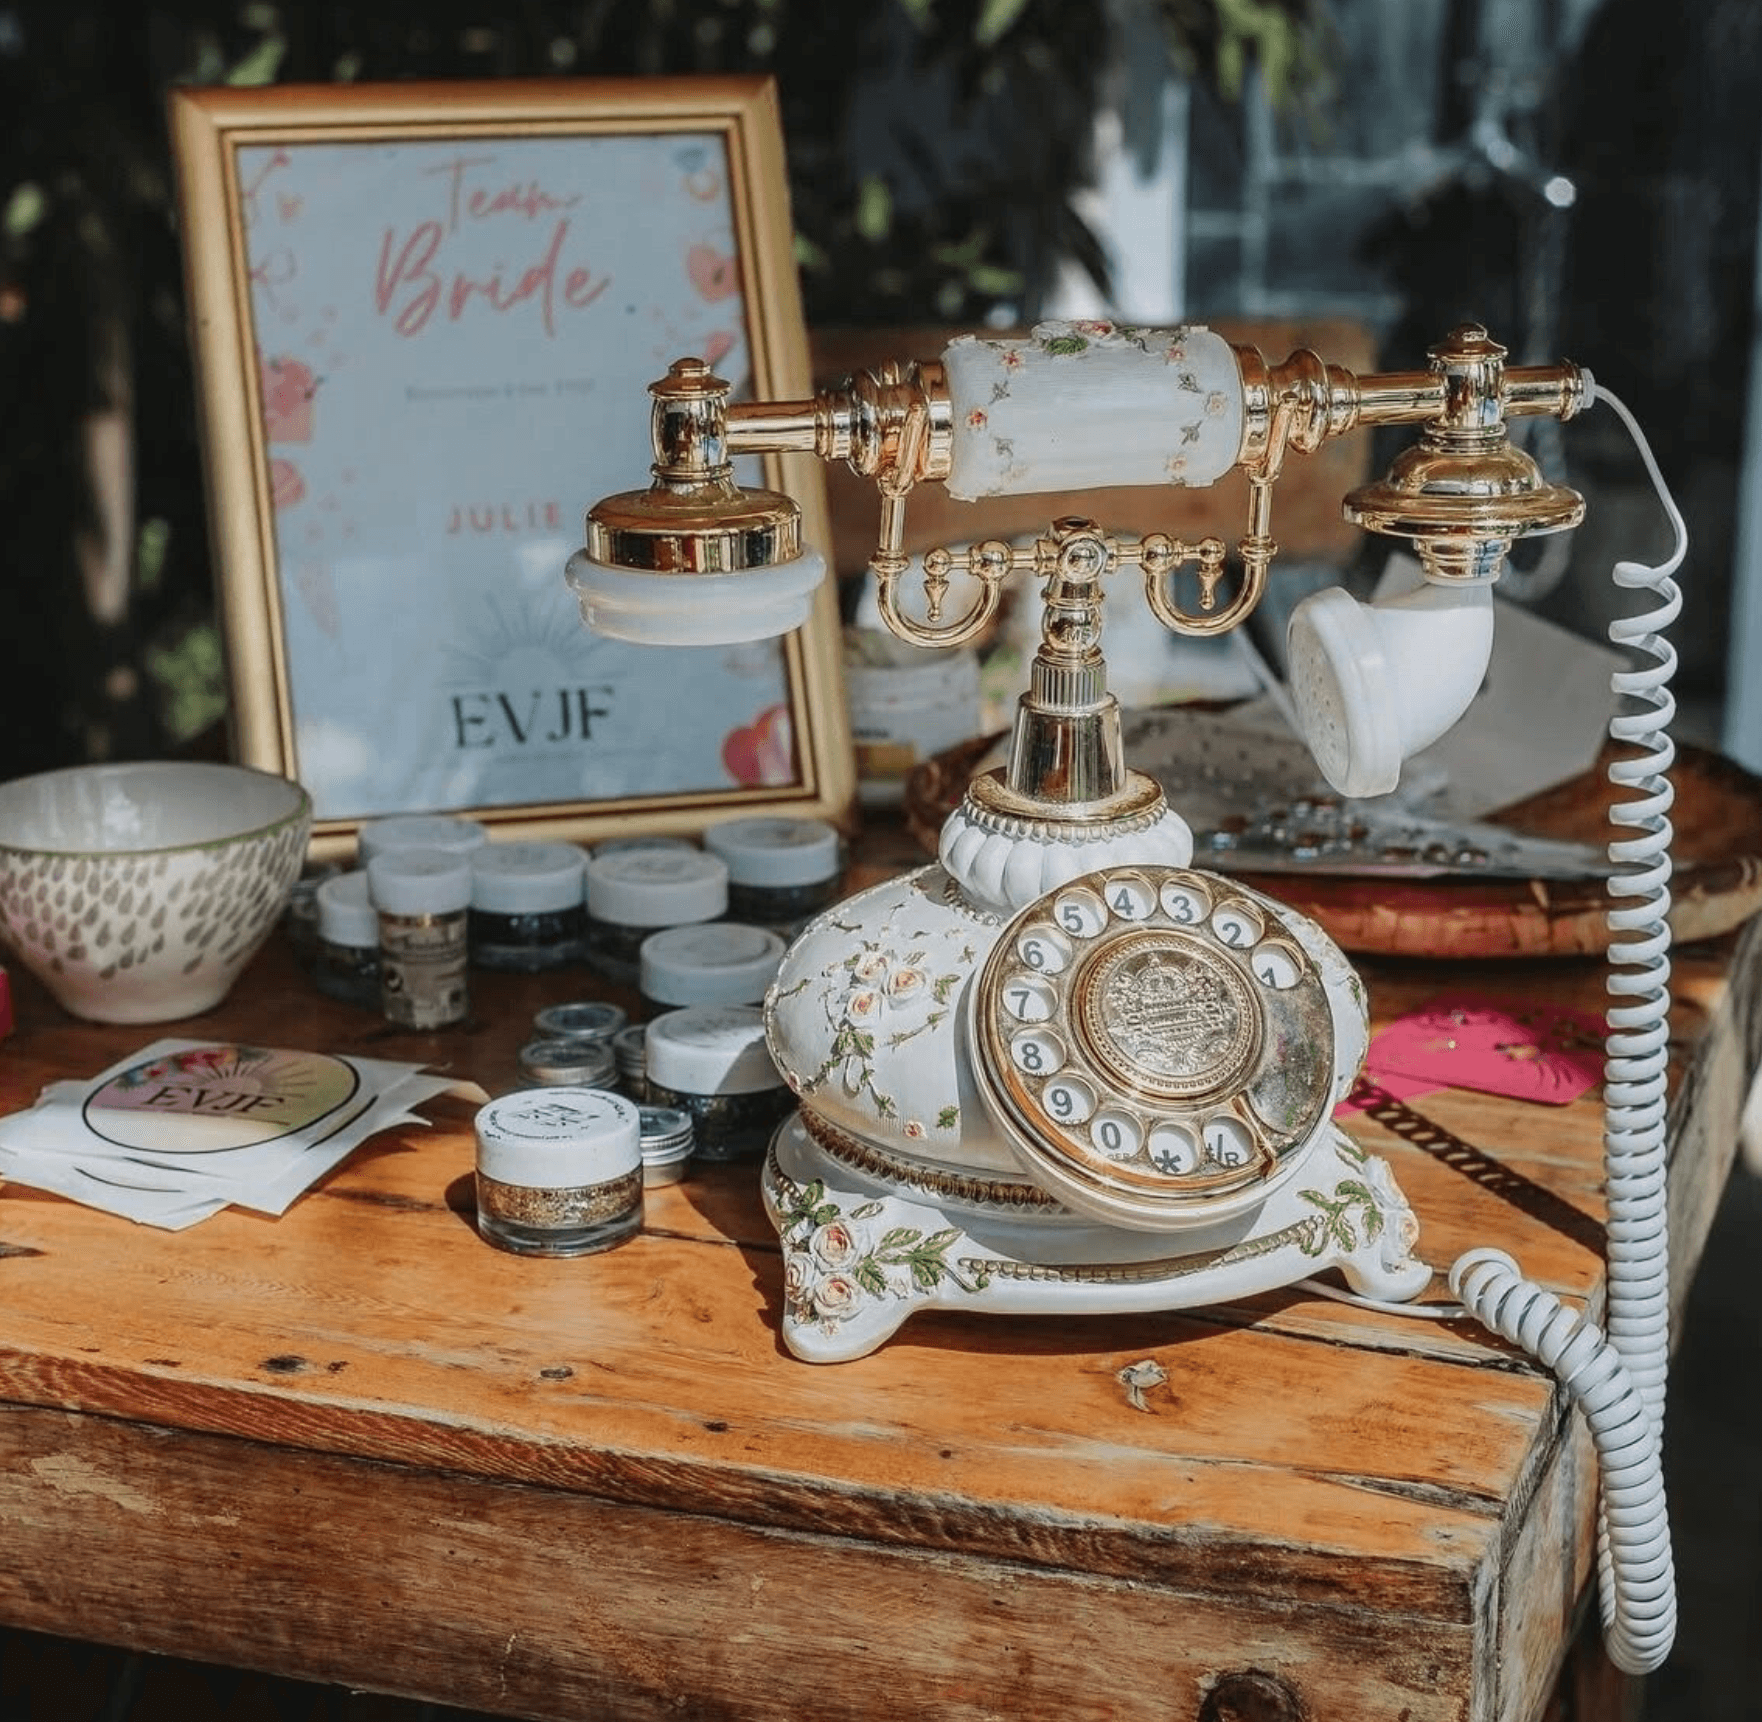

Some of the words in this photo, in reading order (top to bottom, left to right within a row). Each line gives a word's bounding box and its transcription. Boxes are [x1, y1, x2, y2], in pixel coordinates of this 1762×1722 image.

[421, 156, 582, 232] Team
[376, 218, 610, 337] Bride
[447, 502, 560, 534] JULIE
[453, 685, 615, 746] EVJF
[1113, 888, 1134, 915] 4
[1172, 896, 1193, 923] 3
[1063, 905, 1083, 933] 5
[1222, 922, 1244, 948] 2
[1023, 940, 1045, 968] 6
[1260, 967, 1277, 988] 1
[1010, 991, 1030, 1018] 7
[1021, 1042, 1043, 1070] 8
[143, 1085, 286, 1113] EVJF
[1051, 1088, 1073, 1117] 9
[1101, 1122, 1121, 1150] 0
